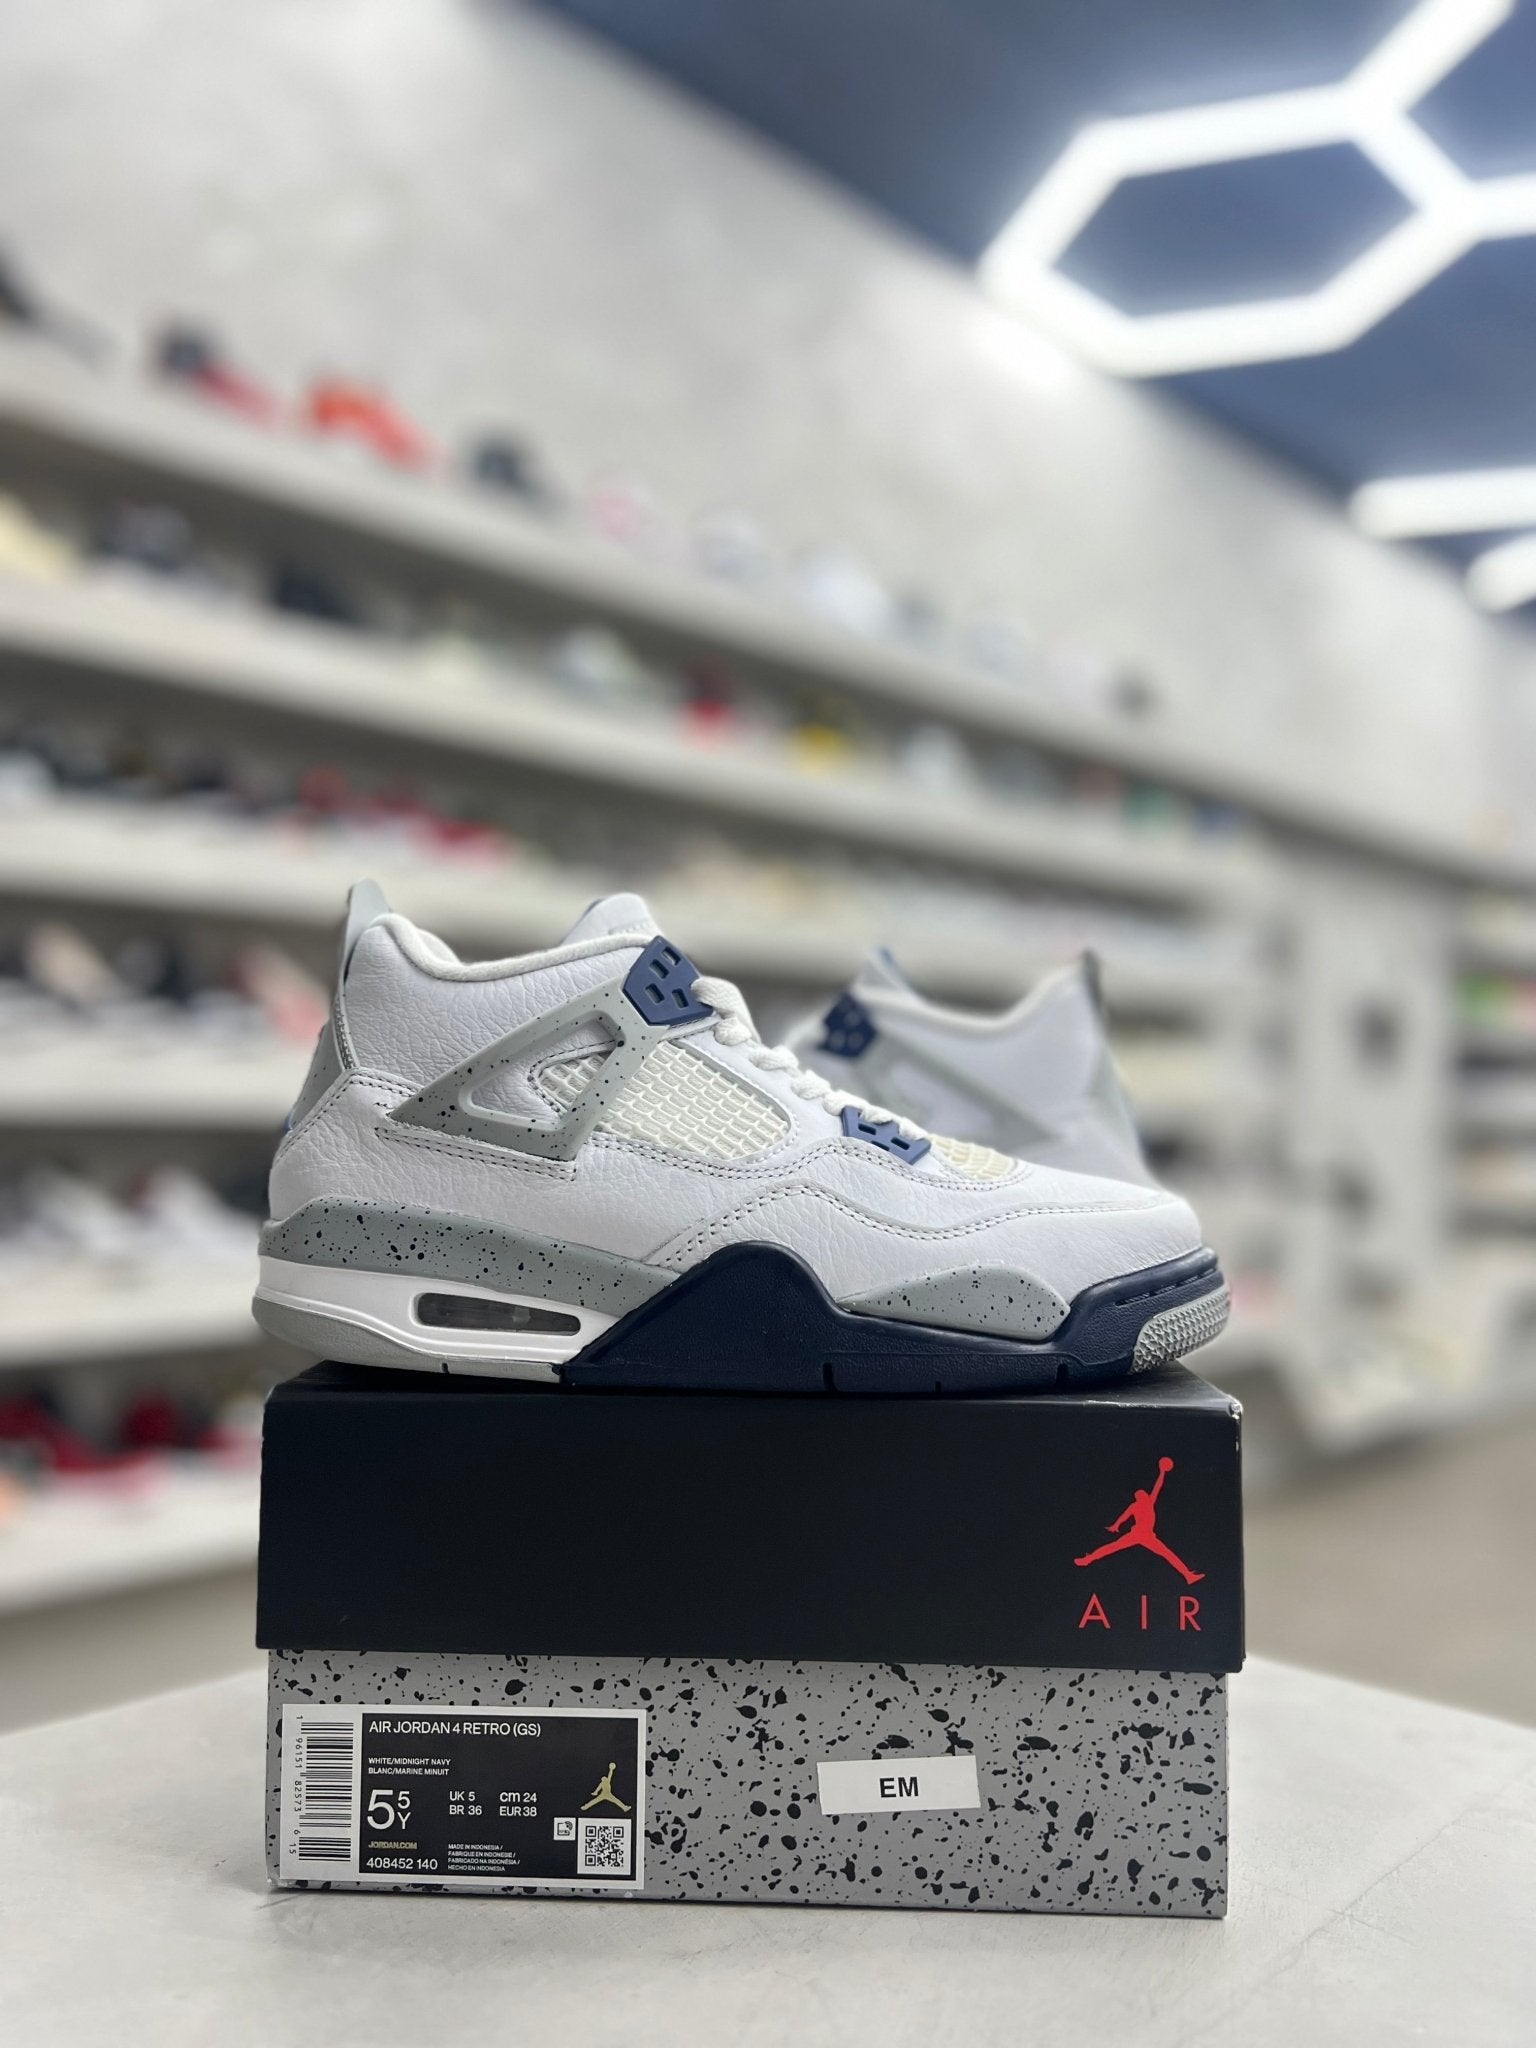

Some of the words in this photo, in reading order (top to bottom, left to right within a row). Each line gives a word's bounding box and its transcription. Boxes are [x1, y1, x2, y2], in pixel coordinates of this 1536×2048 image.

[1078, 1593, 1201, 1631] AIR
[369, 1721, 391, 1733] AIR
[393, 1721, 450, 1734] JORDAN
[452, 1722, 461, 1734] 4
[463, 1723, 511, 1735] RETRO
[513, 1723, 541, 1737] (GS)
[295, 1737, 303, 1769] 96151
[368, 1757, 430, 1766] WHITE/MIDNIGHT
[431, 1758, 451, 1766] NAVY
[368, 1767, 423, 1775] BLANC/MARINE
[424, 1768, 450, 1776] MINUIT
[879, 1776, 919, 1798] EM
[294, 1780, 302, 1812] 82573
[398, 1791, 411, 1809] 5
[449, 1791, 465, 1801] UK
[468, 1791, 476, 1801] 5
[523, 1792, 537, 1803] 24
[367, 1789, 395, 1830] 5
[449, 1805, 465, 1815] BR
[468, 1805, 482, 1816] 36
[499, 1806, 521, 1817] EUR
[522, 1806, 537, 1817] 38
[397, 1812, 411, 1830] Y
[289, 1843, 297, 1854] 15
[368, 1841, 418, 1850] JORDAN.COM
[366, 1857, 413, 1870] 408452
[417, 1858, 438, 1870] 140
